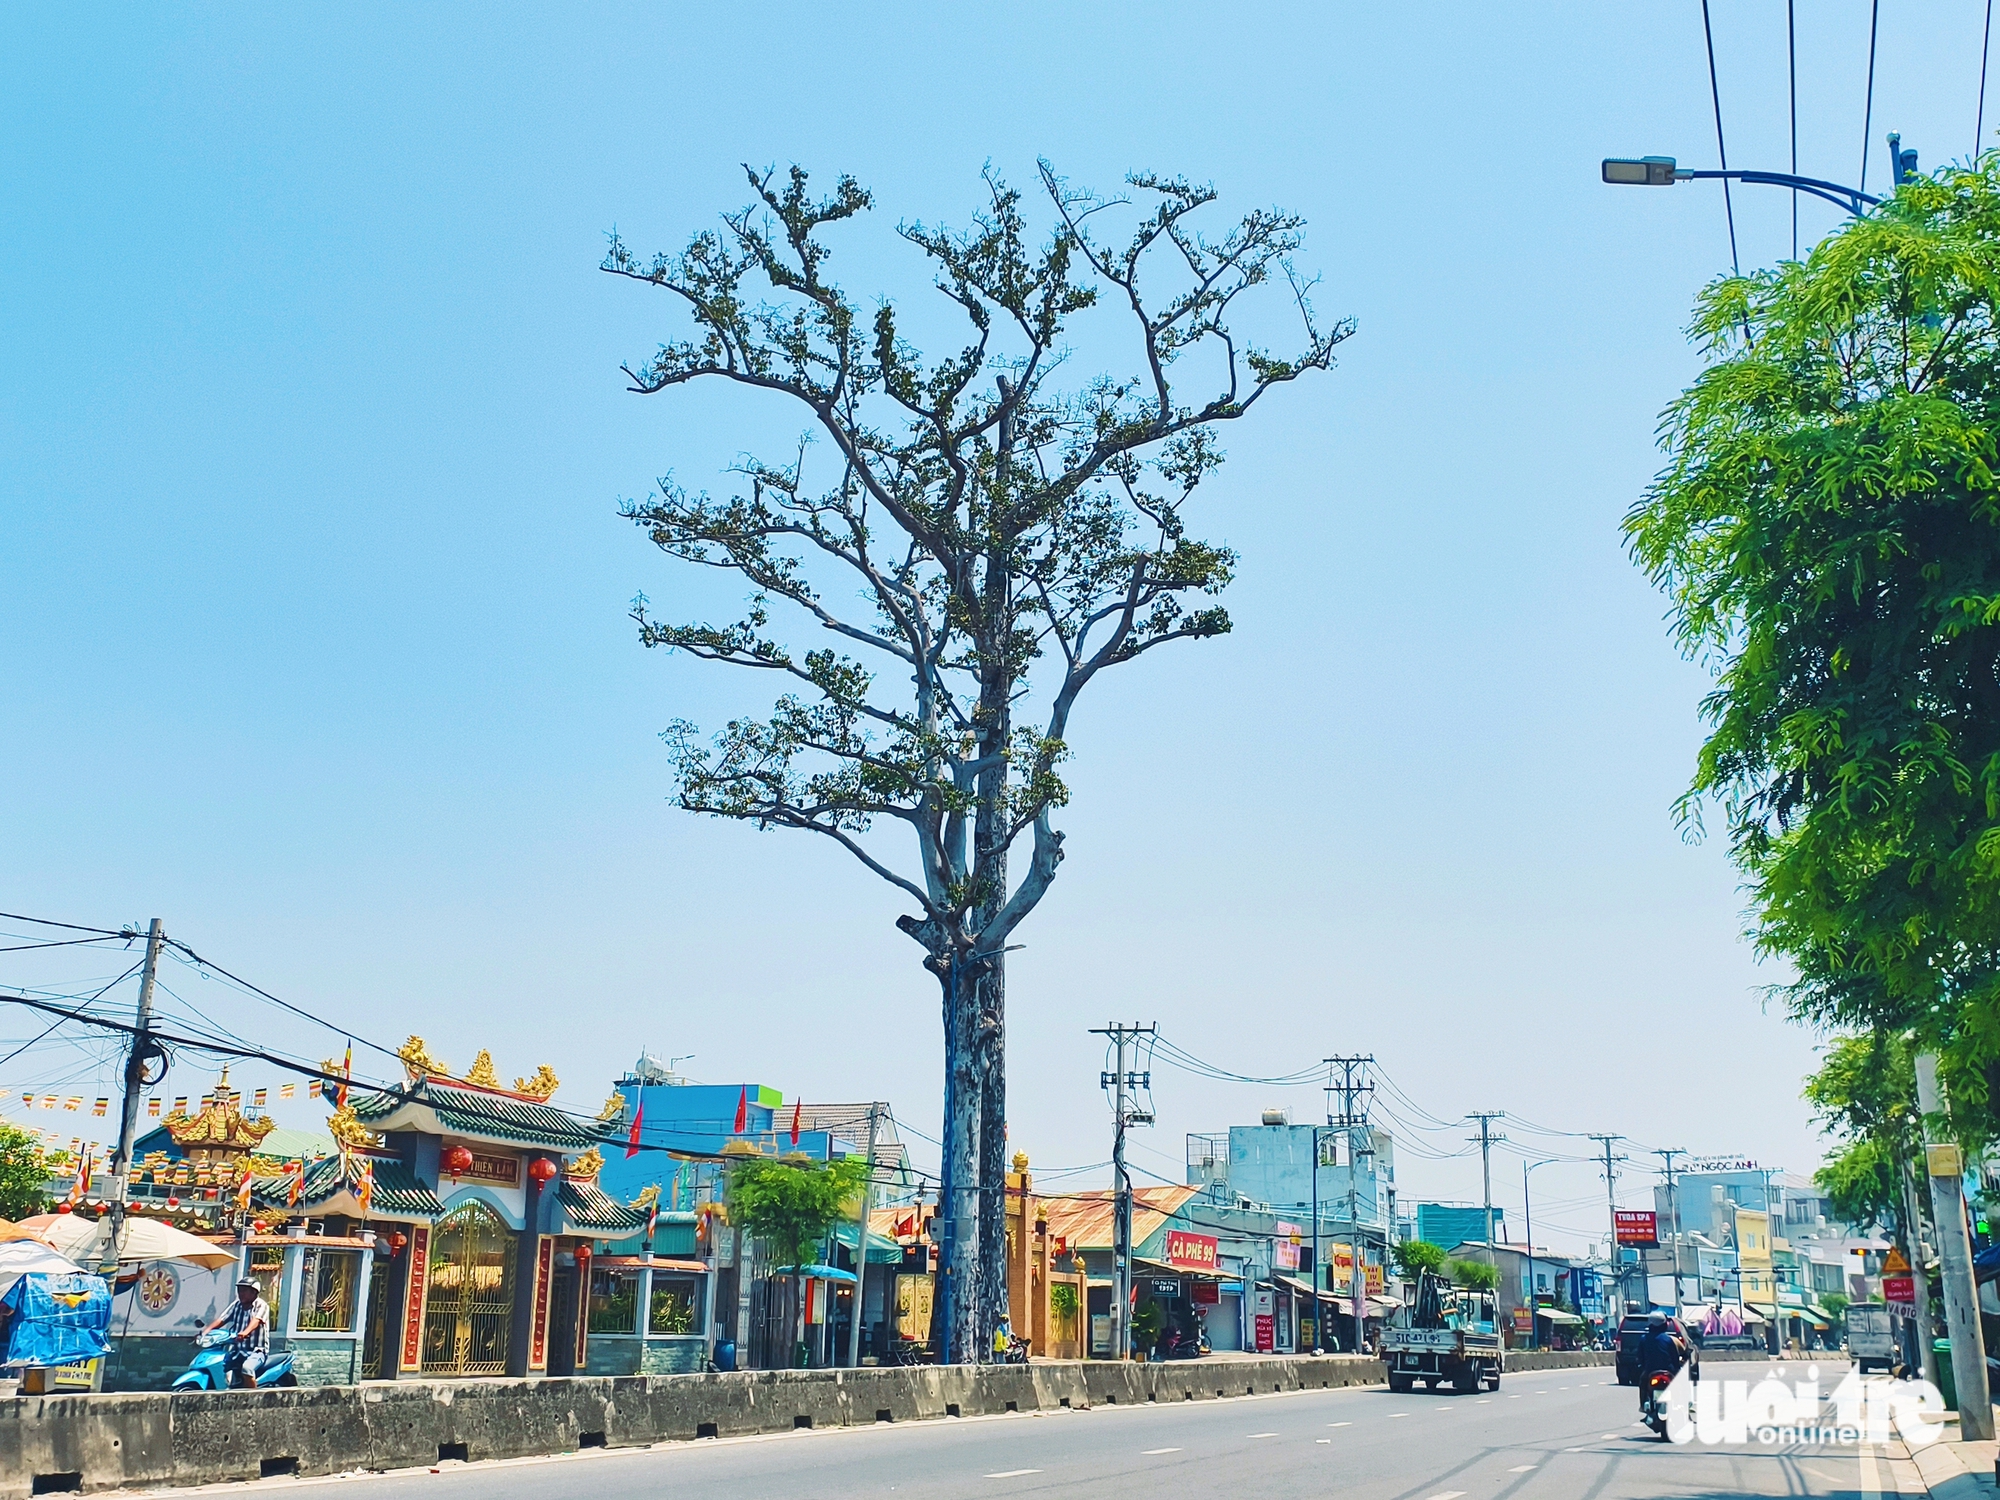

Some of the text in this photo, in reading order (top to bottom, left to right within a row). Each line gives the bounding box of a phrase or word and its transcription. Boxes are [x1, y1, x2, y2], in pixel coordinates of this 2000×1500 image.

[1735, 1160, 1758, 1169] ANH
[1636, 1213, 1651, 1221] SPA
[1172, 1237, 1214, 1262] CÀ PHÊ 99
